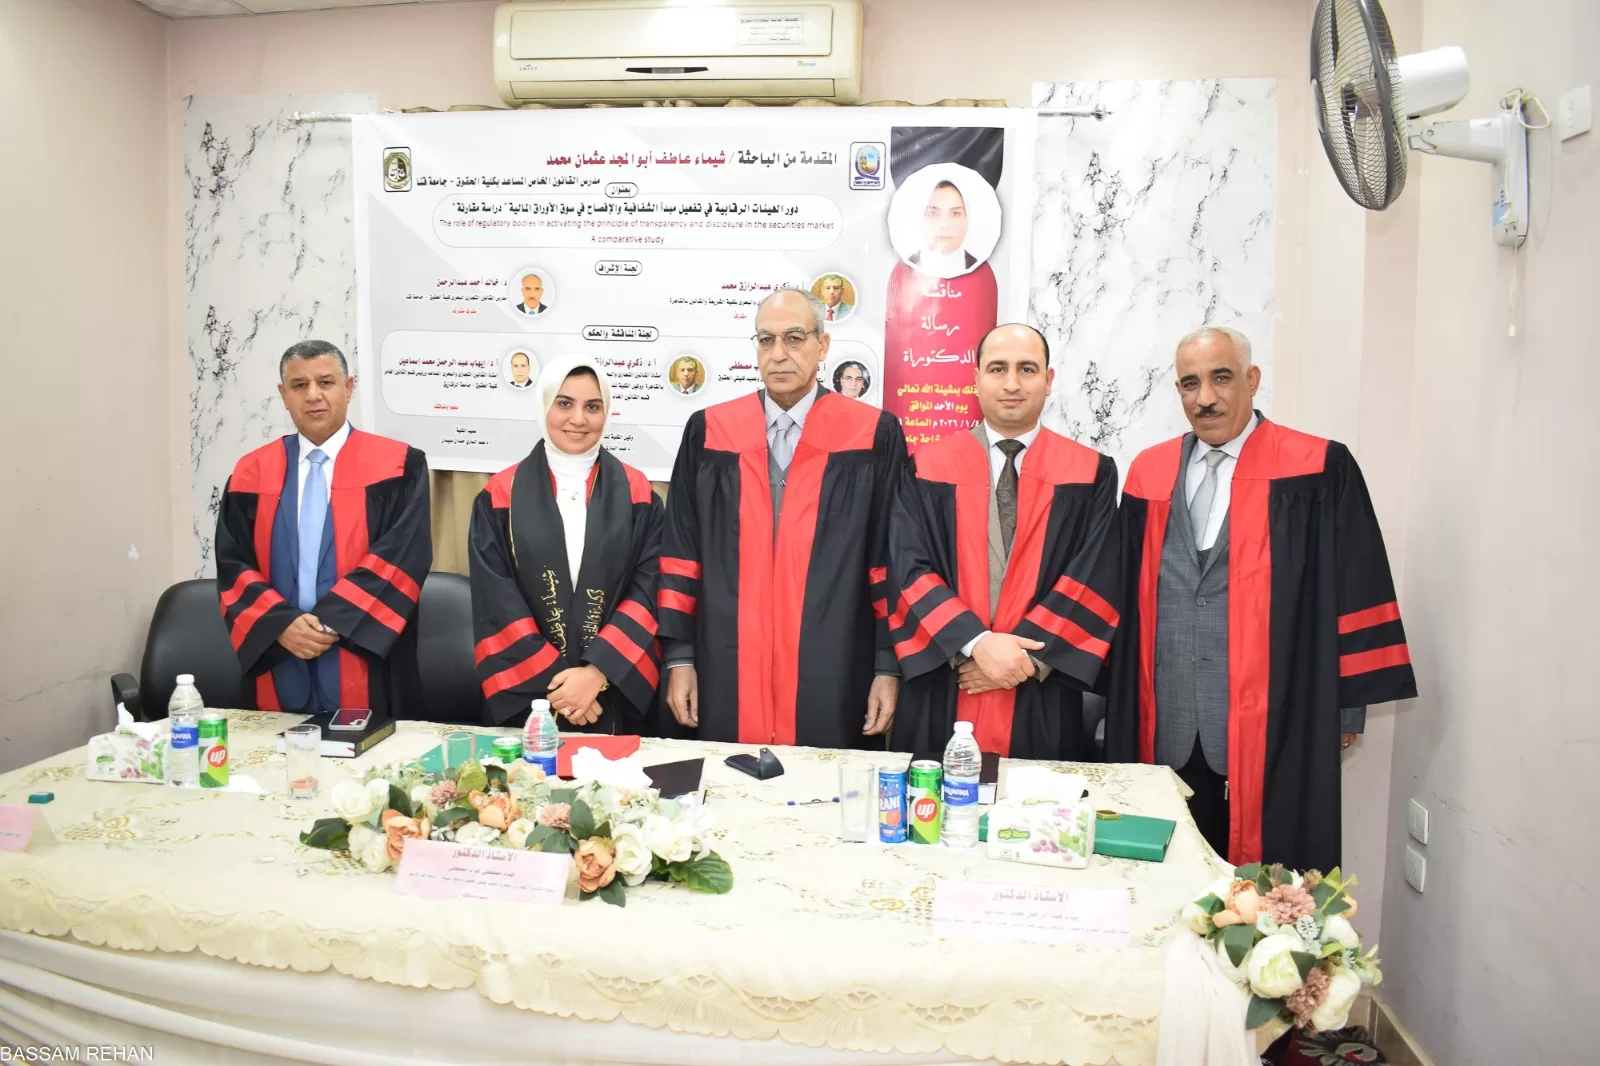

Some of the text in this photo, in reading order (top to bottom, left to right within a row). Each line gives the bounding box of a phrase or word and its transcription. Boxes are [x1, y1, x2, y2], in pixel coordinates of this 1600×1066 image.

[546, 154, 572, 165] محمد
[575, 150, 606, 168] عثمان
[609, 152, 634, 168] المجد
[655, 152, 692, 165] عاطف
[695, 150, 726, 168] شيماء
[738, 149, 780, 168] الباحثة
[783, 153, 797, 168] من
[800, 151, 837, 165] المقدمة
[416, 176, 427, 186] قنا
[428, 176, 447, 187] جامعة
[456, 176, 480, 188] الحقوق
[481, 176, 500, 188] بكلية
[501, 176, 527, 186] المساعد
[528, 176, 551, 188] الخاص
[552, 176, 578, 187] القانون
[580, 177, 600, 187] مدرس
[611, 185, 632, 196] بعنوان
[509, 202, 531, 215] المالية
[560, 203, 575, 215] سوق
[623, 201, 658, 215] الشفافية
[661, 202, 676, 215] مبدأ
[678, 202, 702, 215] تفعيل
[715, 202, 750, 216] الرقابية
[784, 205, 799, 216] دور
[440, 219, 451, 227] The
[453, 219, 466, 227] role
[468, 219, 475, 227] of
[476, 219, 510, 229] regulatory
[512, 219, 536, 228] bodies
[538, 220, 544, 228] in
[546, 220, 581, 229] activating
[584, 220, 595, 228] the
[597, 220, 628, 229] principle
[631, 220, 639, 228] of
[640, 220, 687, 229] transparency
[689, 220, 704, 228] and
[706, 220, 743, 229] disclosure
[754, 221, 767, 229] the
[769, 221, 805, 229] securities
[807, 221, 834, 229] market
[591, 235, 664, 244] A comparative study
[624, 264, 639, 274] لجنة
[921, 313, 960, 336] رسالة
[638, 329, 652, 339] لجنة
[921, 383, 933, 393] الله
[962, 385, 978, 395] ذلك
[909, 400, 932, 412] الموافق
[955, 403, 968, 414] يوم
[904, 416, 931, 427] الساعة
